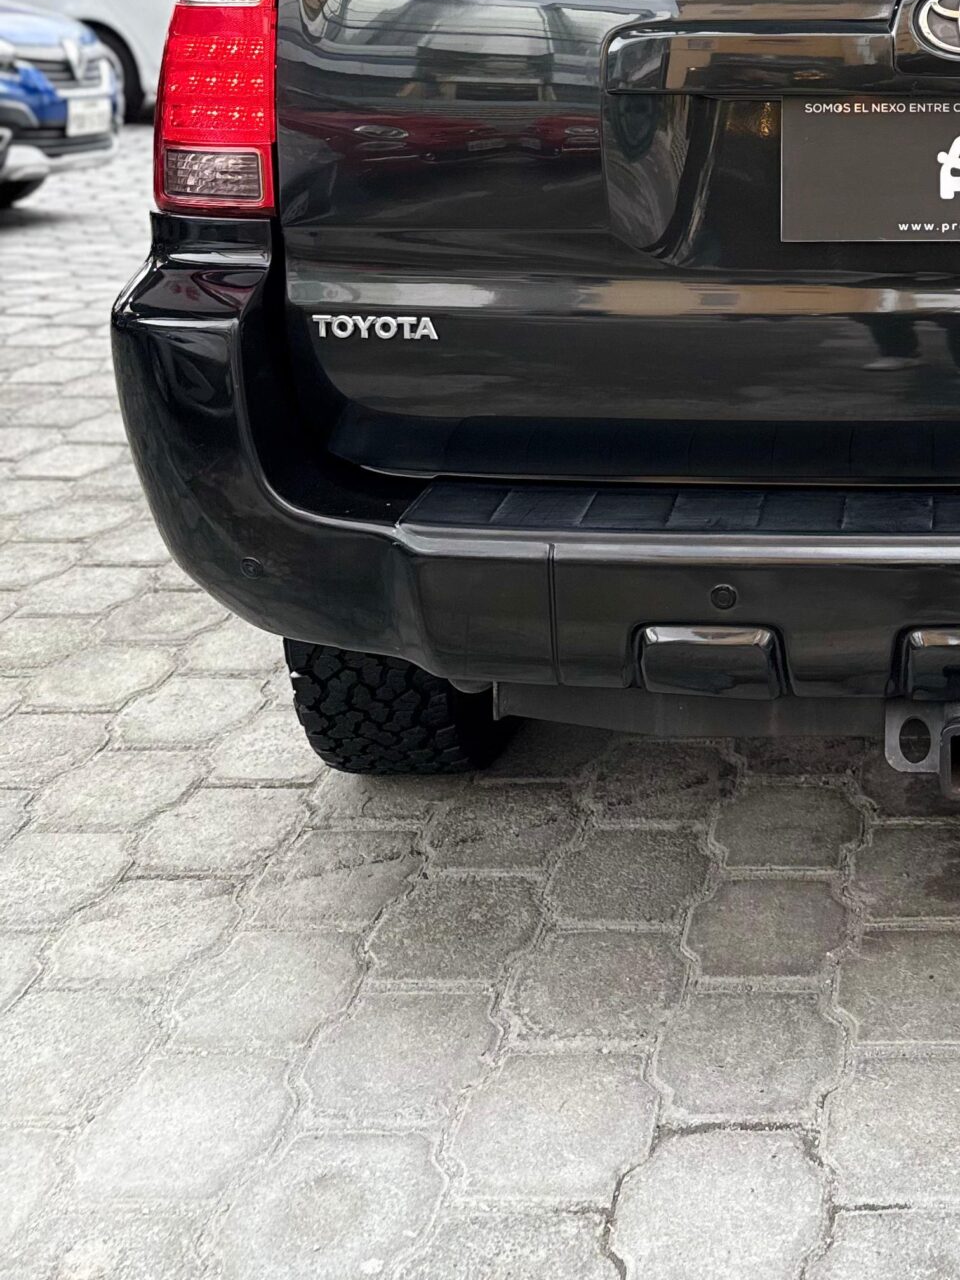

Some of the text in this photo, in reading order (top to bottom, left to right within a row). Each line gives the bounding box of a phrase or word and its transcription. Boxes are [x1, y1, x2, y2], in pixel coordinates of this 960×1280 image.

[804, 103, 851, 113] SOMOS
[854, 103, 869, 113] EL
[872, 103, 906, 113] NEXO
[909, 103, 950, 113] ENTRE
[312, 314, 439, 340] TOYOTA
